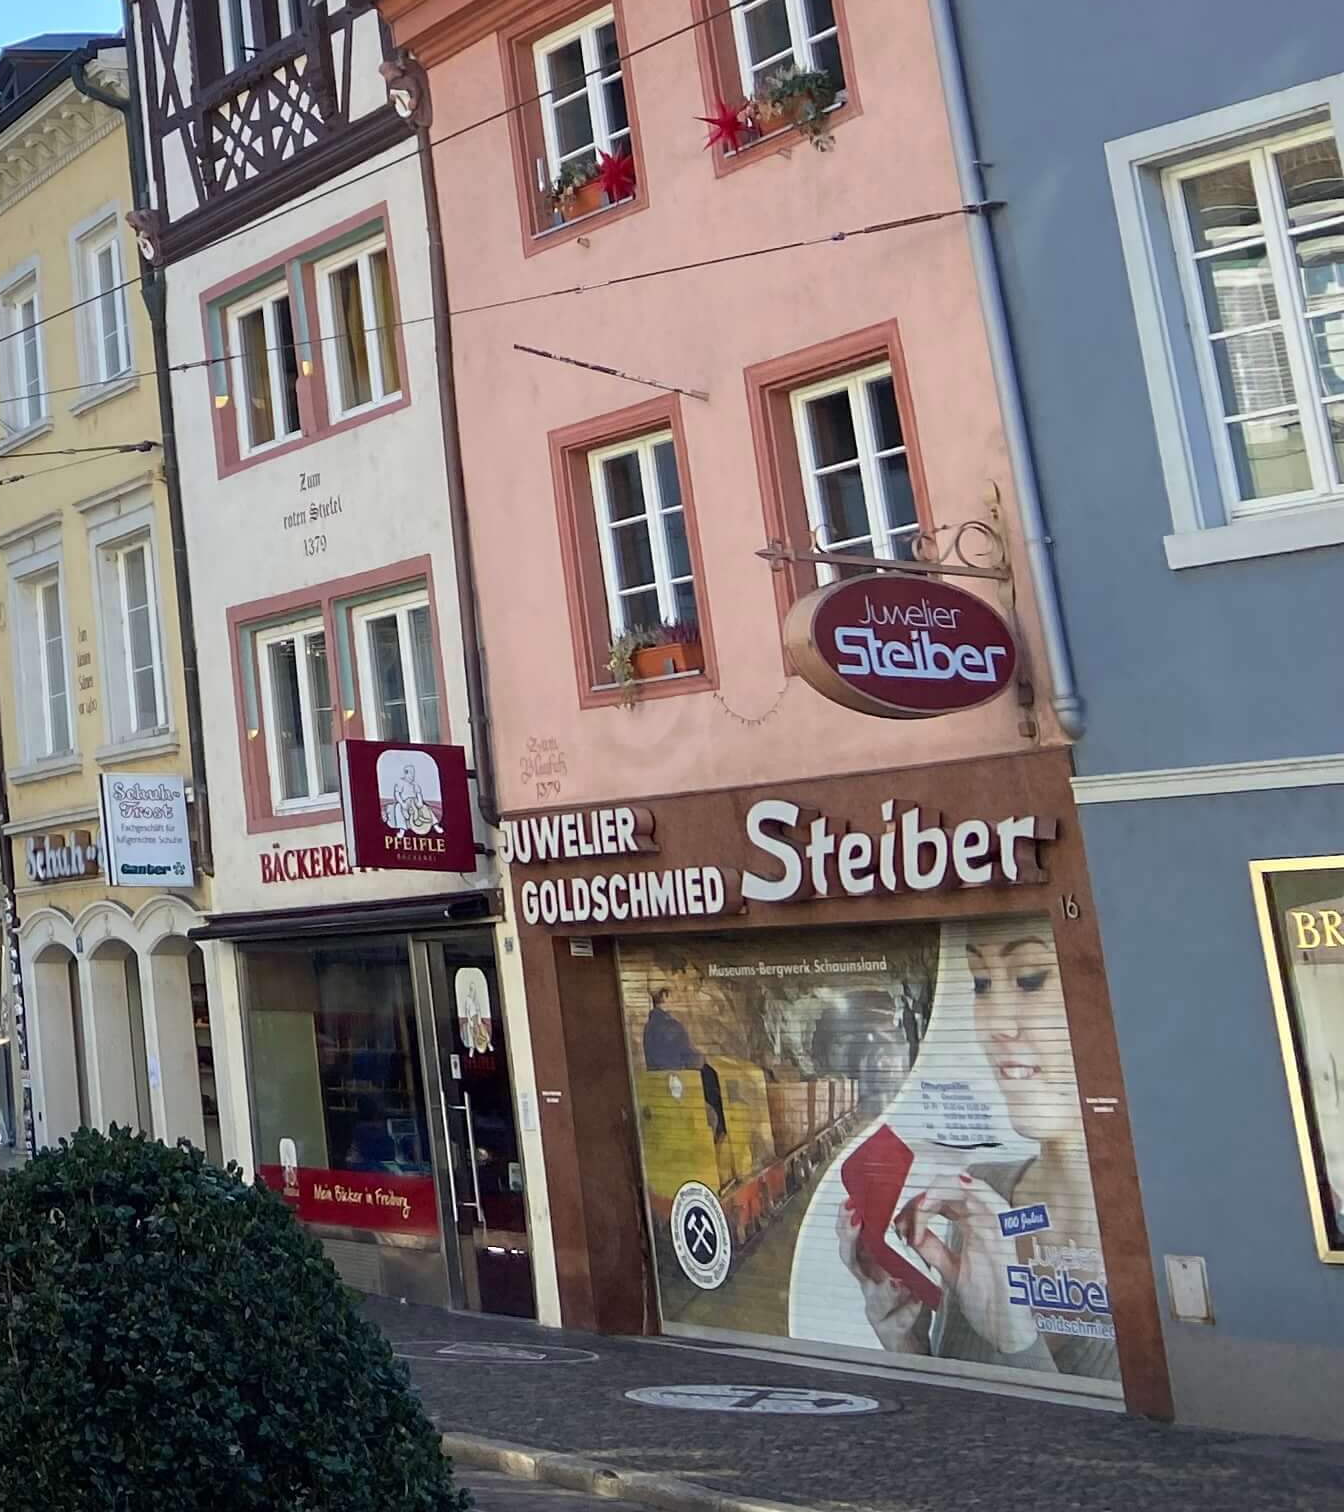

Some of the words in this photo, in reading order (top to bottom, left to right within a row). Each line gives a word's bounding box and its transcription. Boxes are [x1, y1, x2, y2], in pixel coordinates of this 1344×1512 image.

[299, 473, 320, 492] Zum
[283, 510, 307, 530] roten
[303, 534, 327, 557] 1379
[859, 595, 960, 628] Juwelier
[834, 626, 1006, 682] Steiber
[384, 835, 446, 852] PFEIFLE
[499, 807, 639, 864] JUWELIER
[742, 798, 1035, 902] Steiber
[260, 843, 354, 884] BÄCKERE
[521, 866, 724, 925] GOLDSCHMIED
[1060, 893, 1080, 920] 16
[1292, 909, 1344, 949] BR
[709, 959, 810, 978] Museums-Bergwerk
[814, 956, 887, 973] Schauinsland
[335, 1184, 363, 1203] Bäcker
[365, 1187, 373, 1205] in
[375, 1188, 412, 1219] Freiburg
[1004, 1217, 1019, 1229] 100
[1007, 1265, 1111, 1313] Steibe
